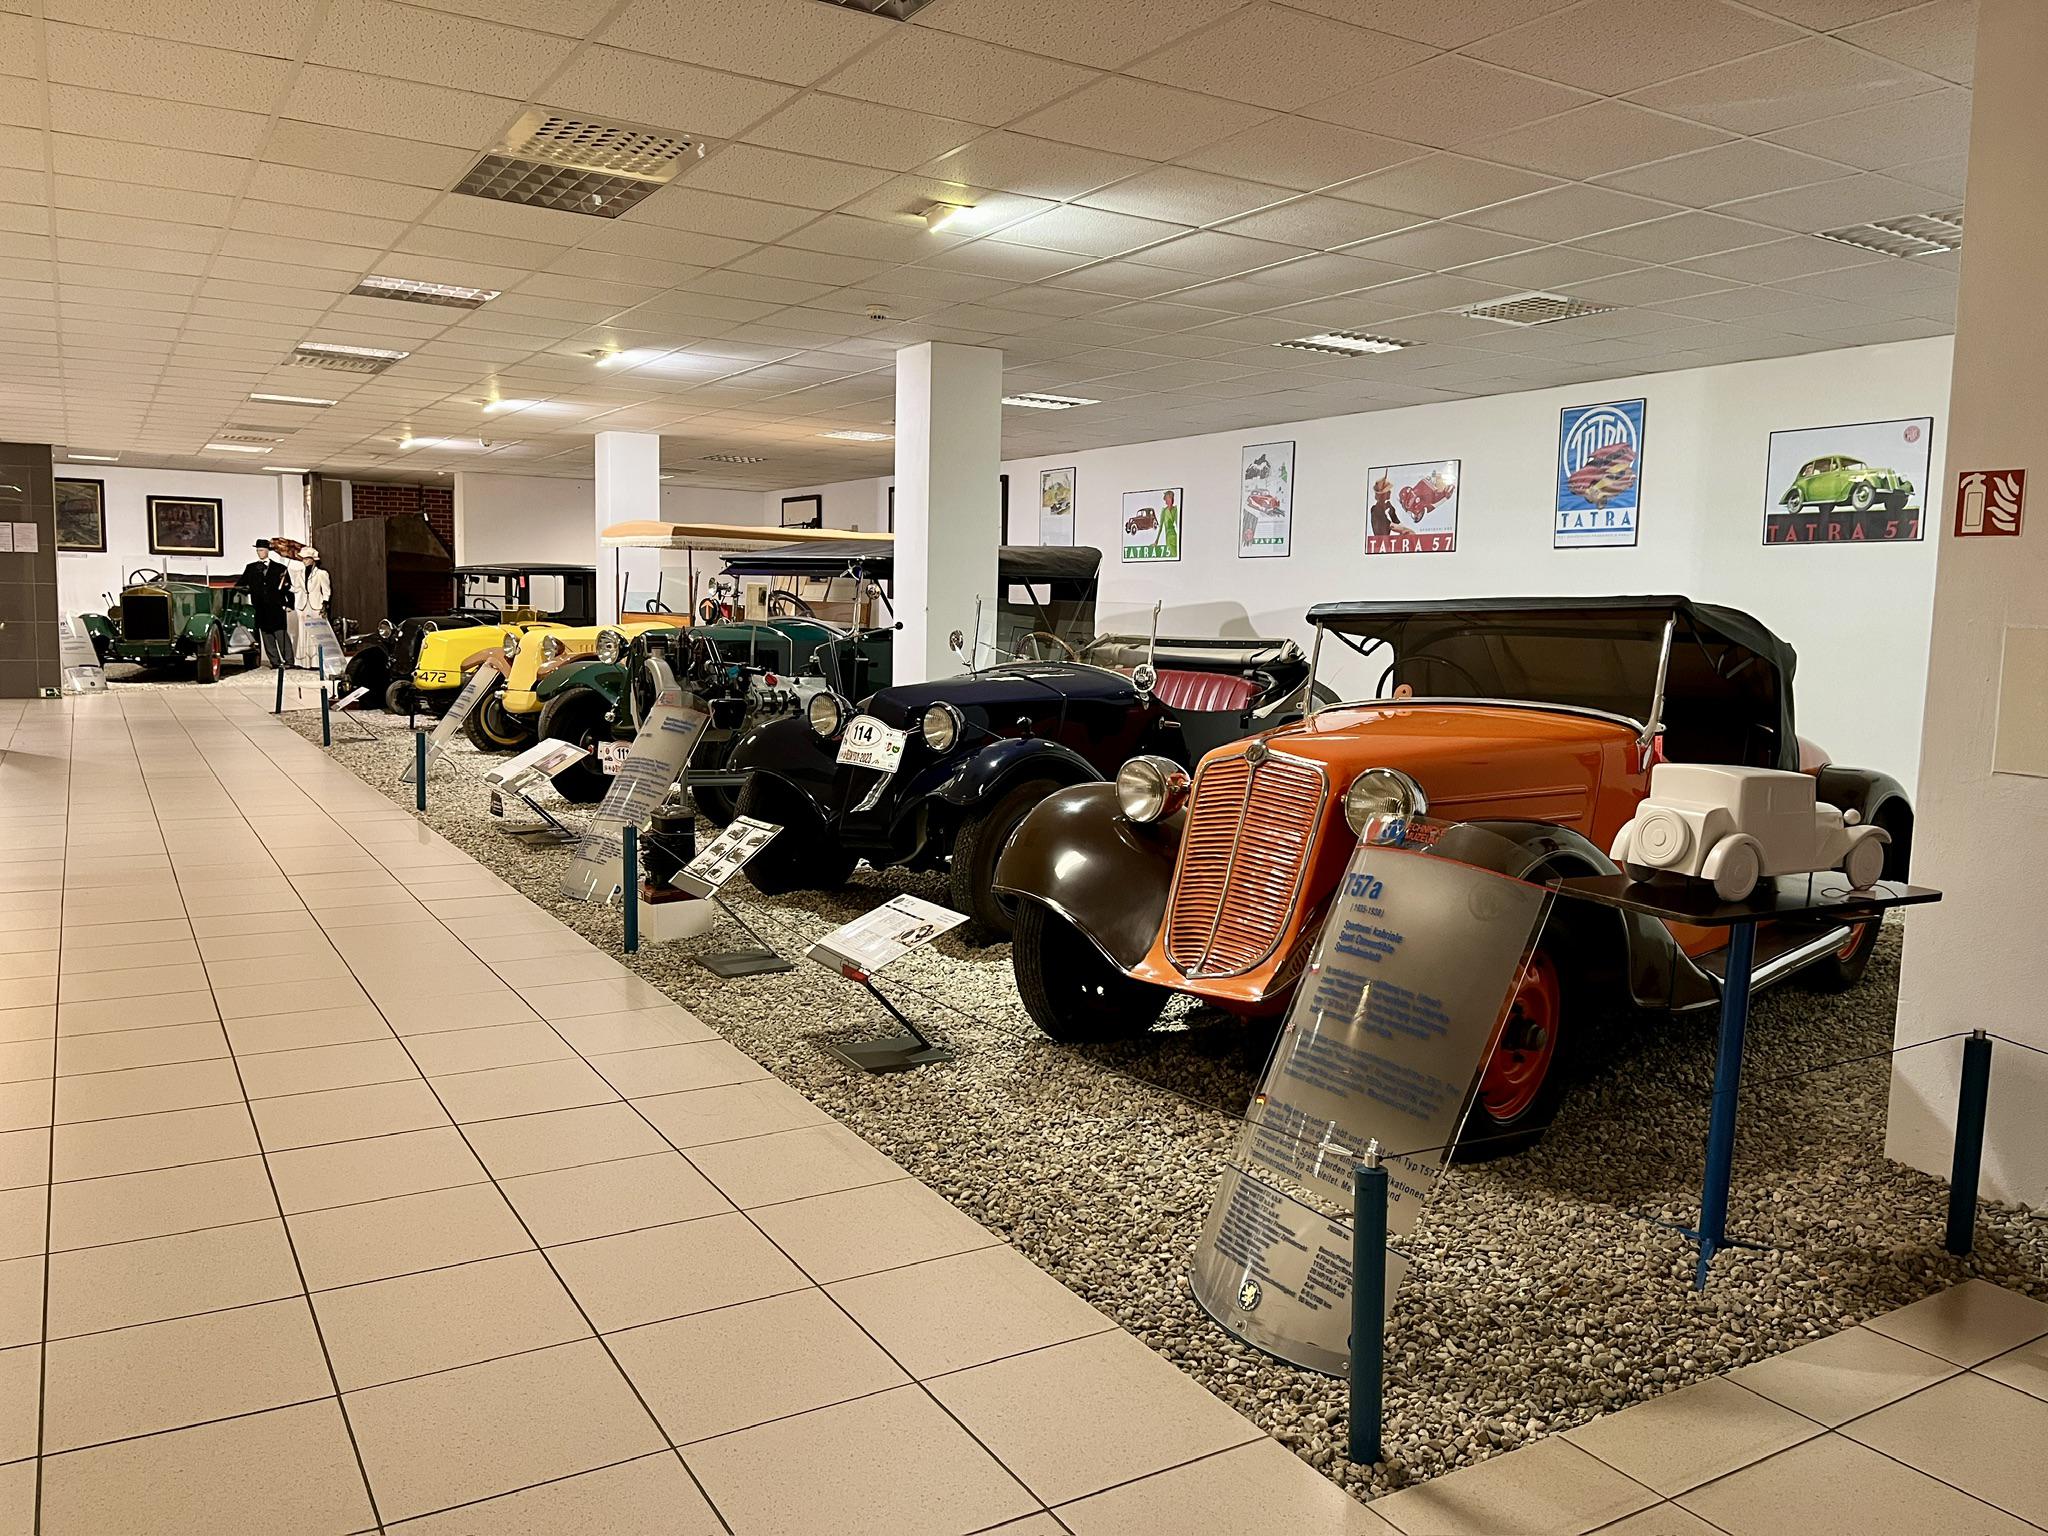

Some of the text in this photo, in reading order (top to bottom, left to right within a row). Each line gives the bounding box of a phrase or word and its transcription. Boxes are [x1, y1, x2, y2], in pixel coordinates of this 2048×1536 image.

[1562, 510, 1631, 528] TATRA
[1768, 519, 1918, 542] TATRA 57
[1124, 545, 1171, 558] TATRA 75
[1370, 536, 1452, 553] TATRA 57
[419, 671, 447, 683] 472
[853, 725, 874, 742] 114
[1404, 1156, 1418, 1173] Typ
[1306, 1162, 1340, 1186] abeleitet.
